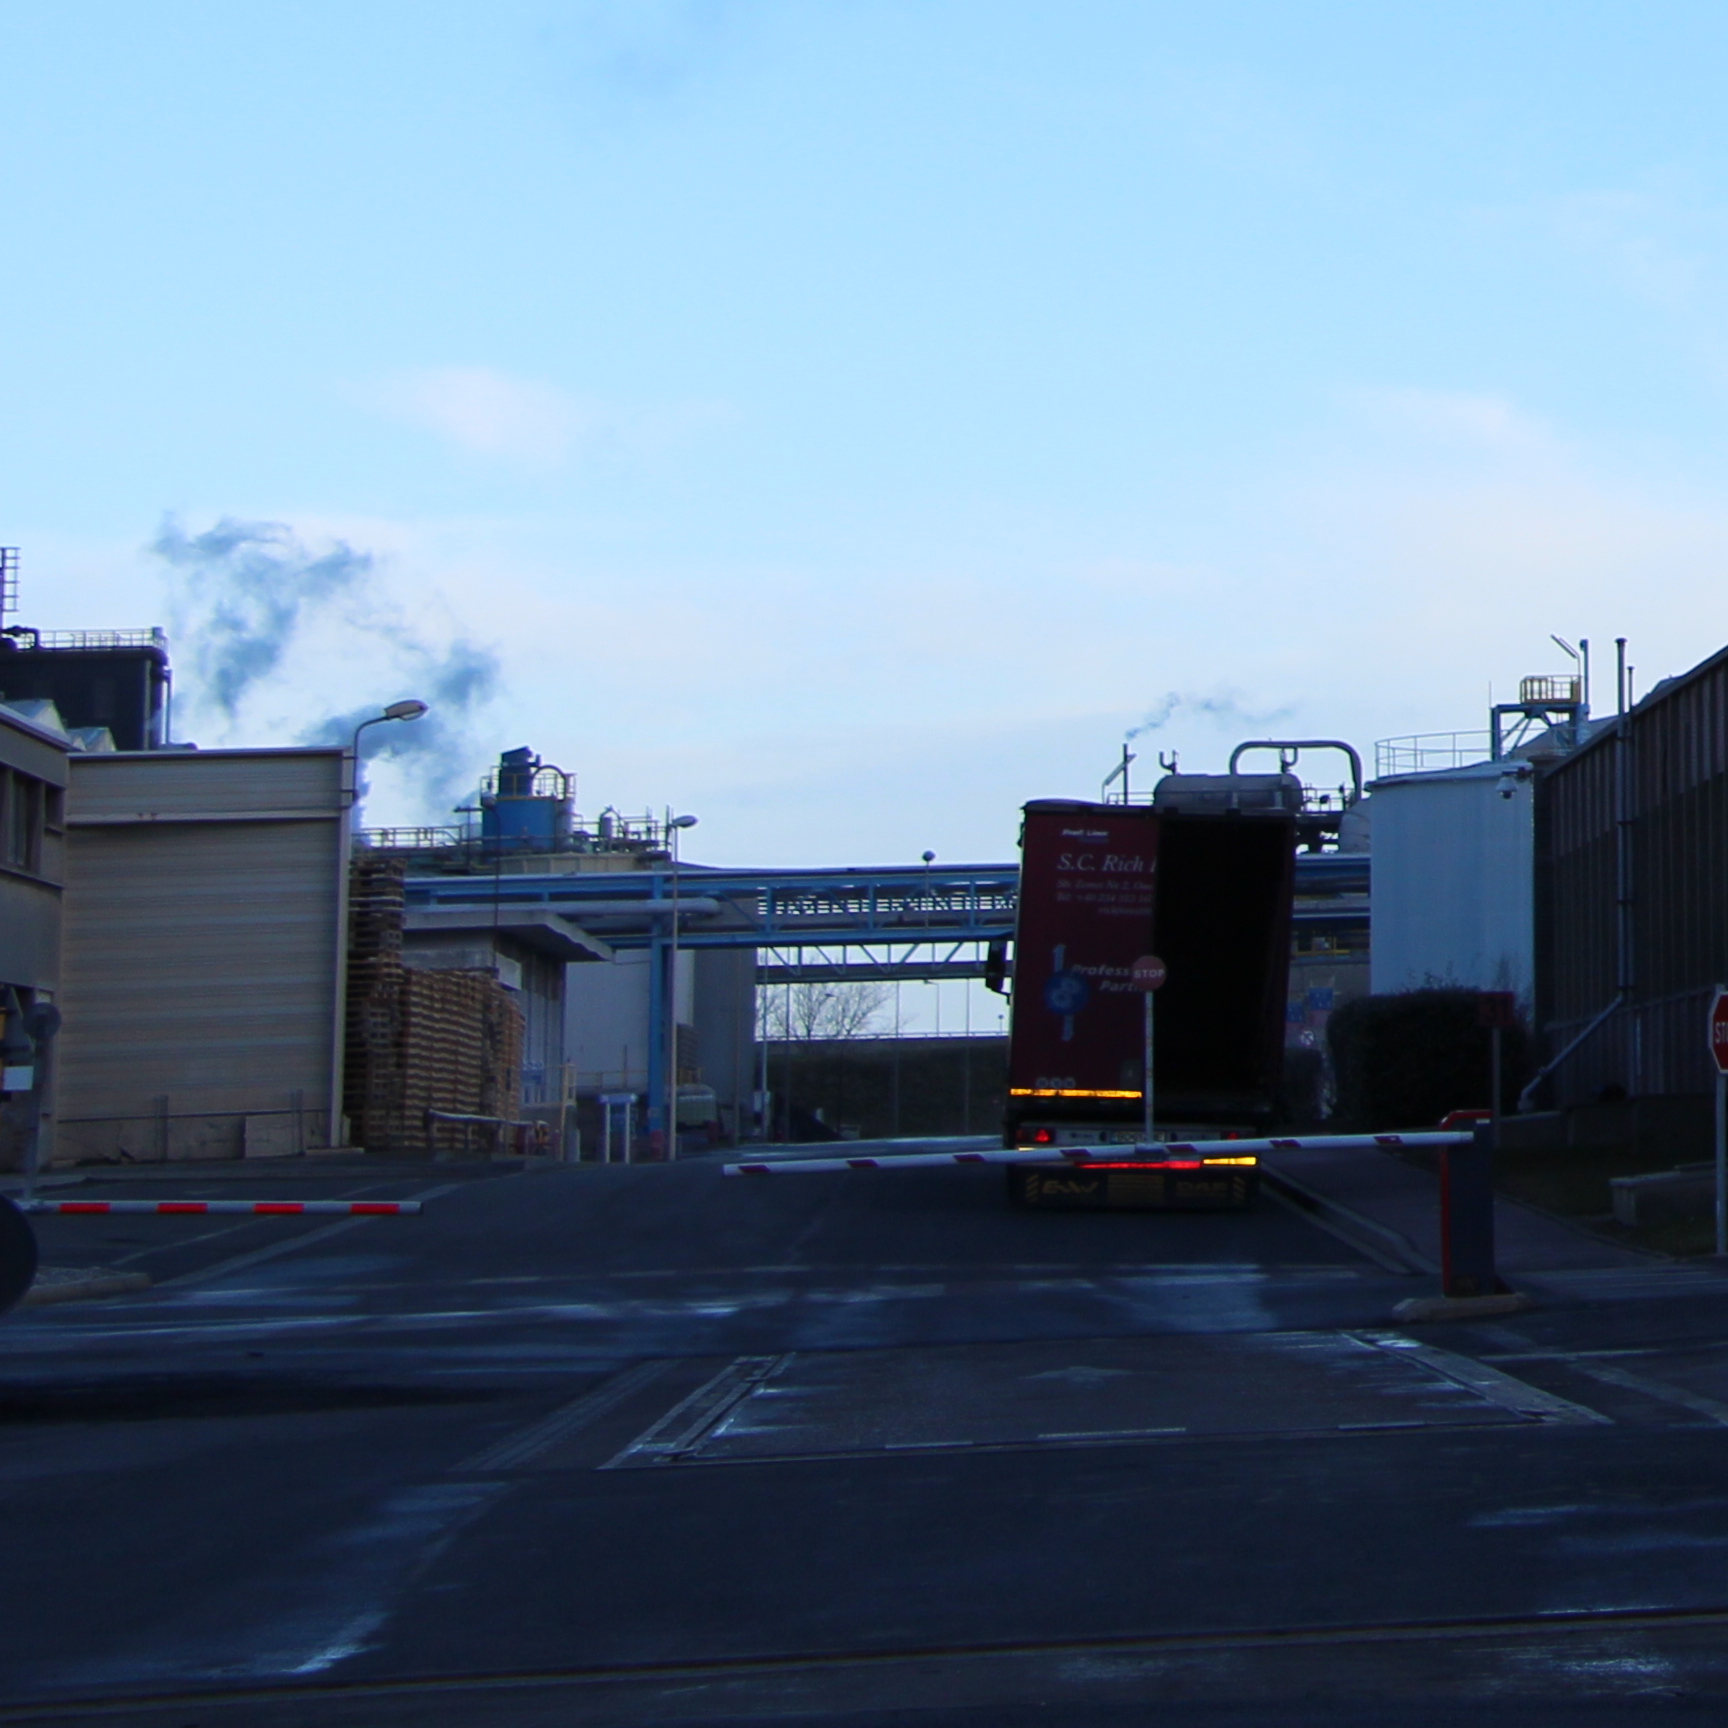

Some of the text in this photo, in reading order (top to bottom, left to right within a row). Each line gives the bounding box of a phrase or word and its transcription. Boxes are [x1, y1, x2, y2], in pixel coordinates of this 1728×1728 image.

[1101, 854, 1144, 873] Rich
[1070, 964, 1132, 977] Profess
[1133, 969, 1165, 979] STOP
